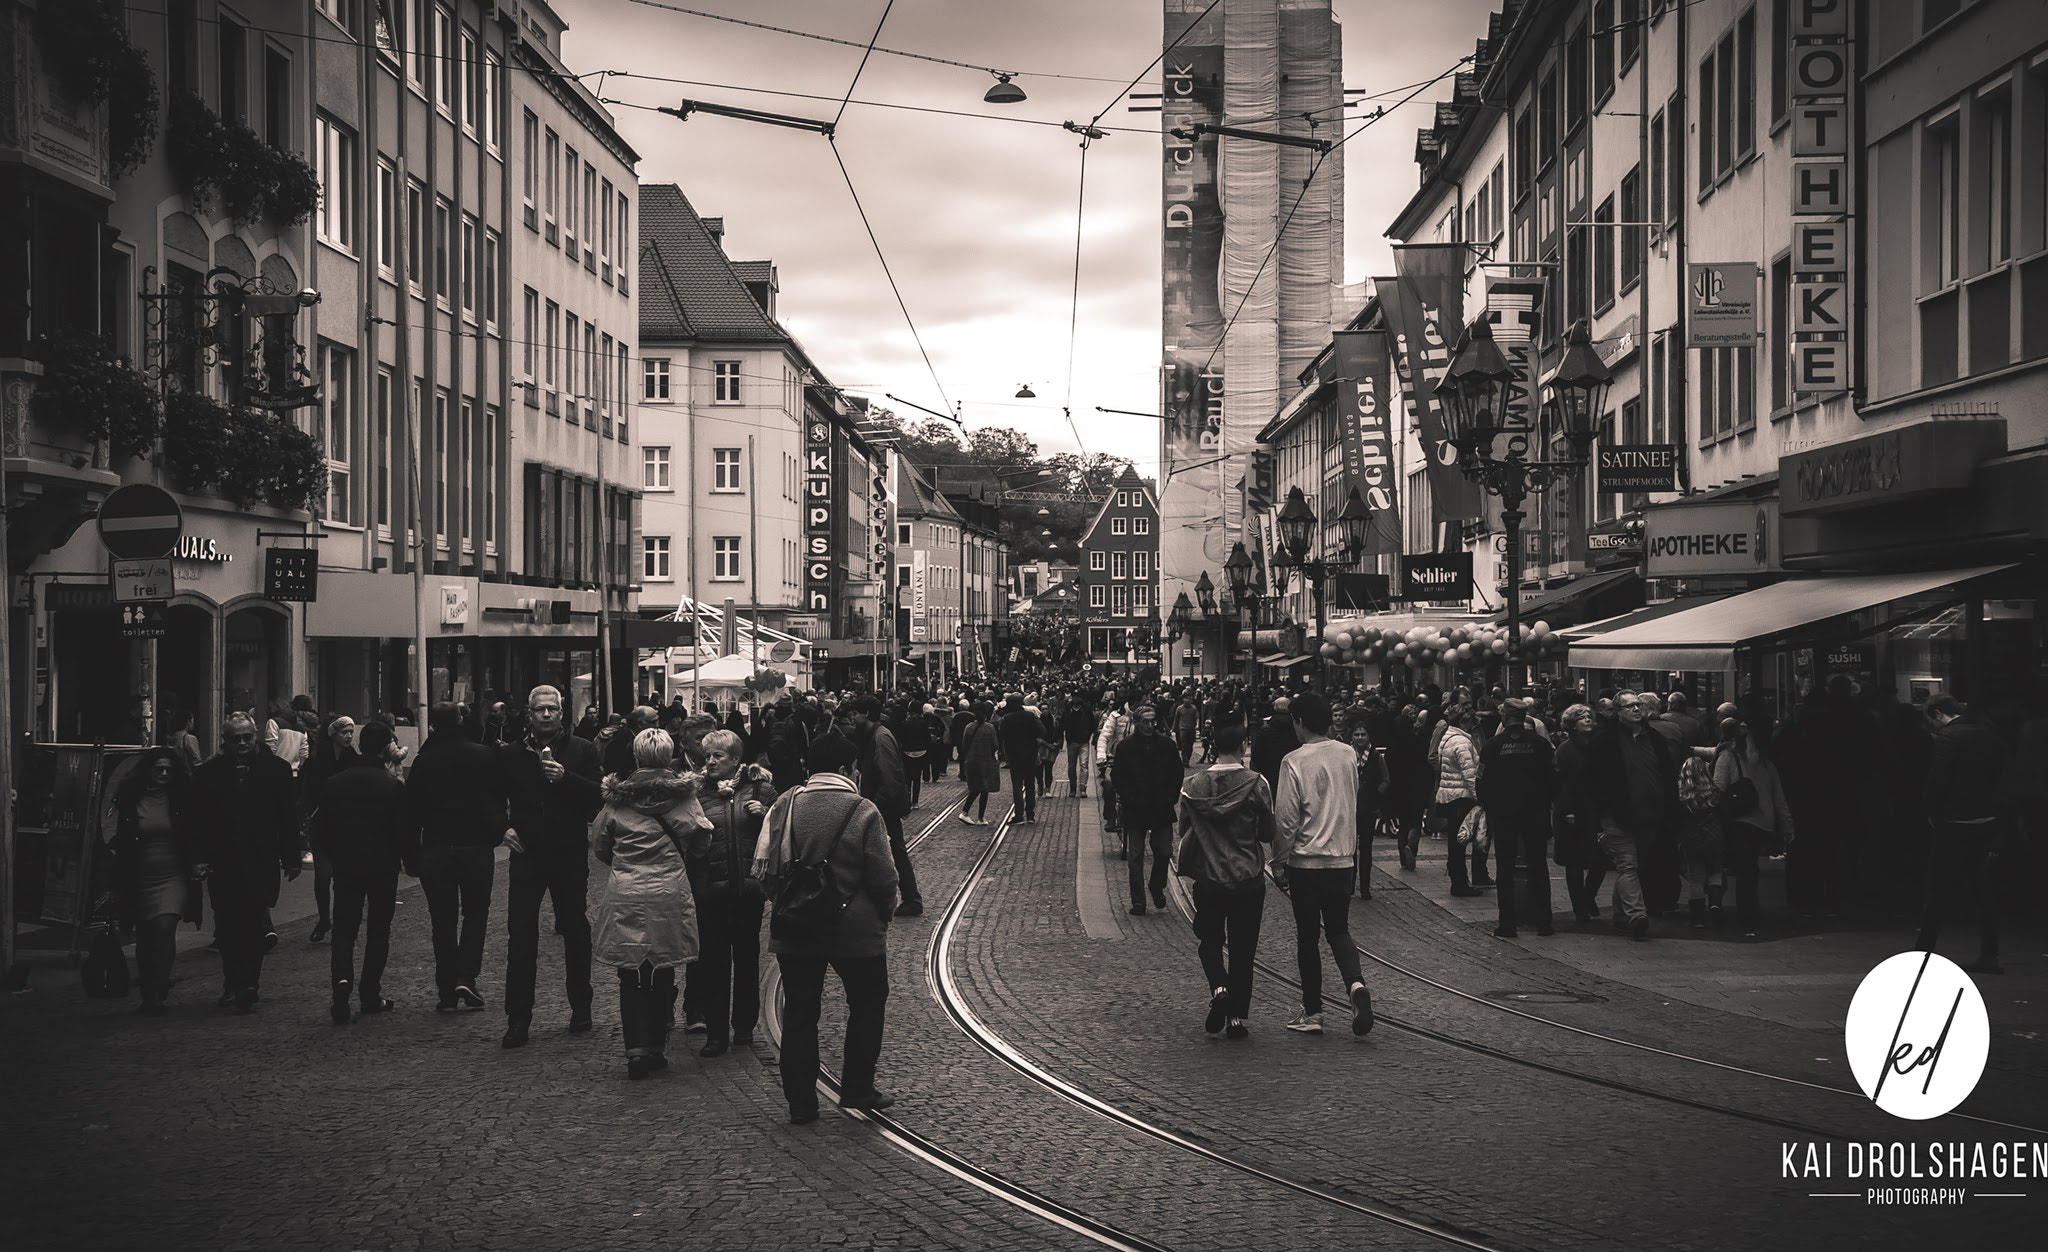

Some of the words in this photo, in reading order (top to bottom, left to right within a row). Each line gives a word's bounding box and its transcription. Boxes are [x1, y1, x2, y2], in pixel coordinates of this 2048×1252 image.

[1694, 333, 1752, 343] Beratungsstelle
[1200, 363, 1225, 450] Rauch
[1602, 451, 1671, 468] SATINEE
[1603, 478, 1671, 486] STRUMPFMODEN
[810, 451, 829, 610] kupsch
[872, 476, 888, 575] Sever
[1650, 533, 1748, 558] APOTHEKE
[1411, 567, 1458, 584] Schlier
[134, 584, 157, 596] frei
[914, 570, 924, 615] FONTANA
[123, 628, 165, 636] toiletten
[1827, 653, 1862, 664] SUSHI
